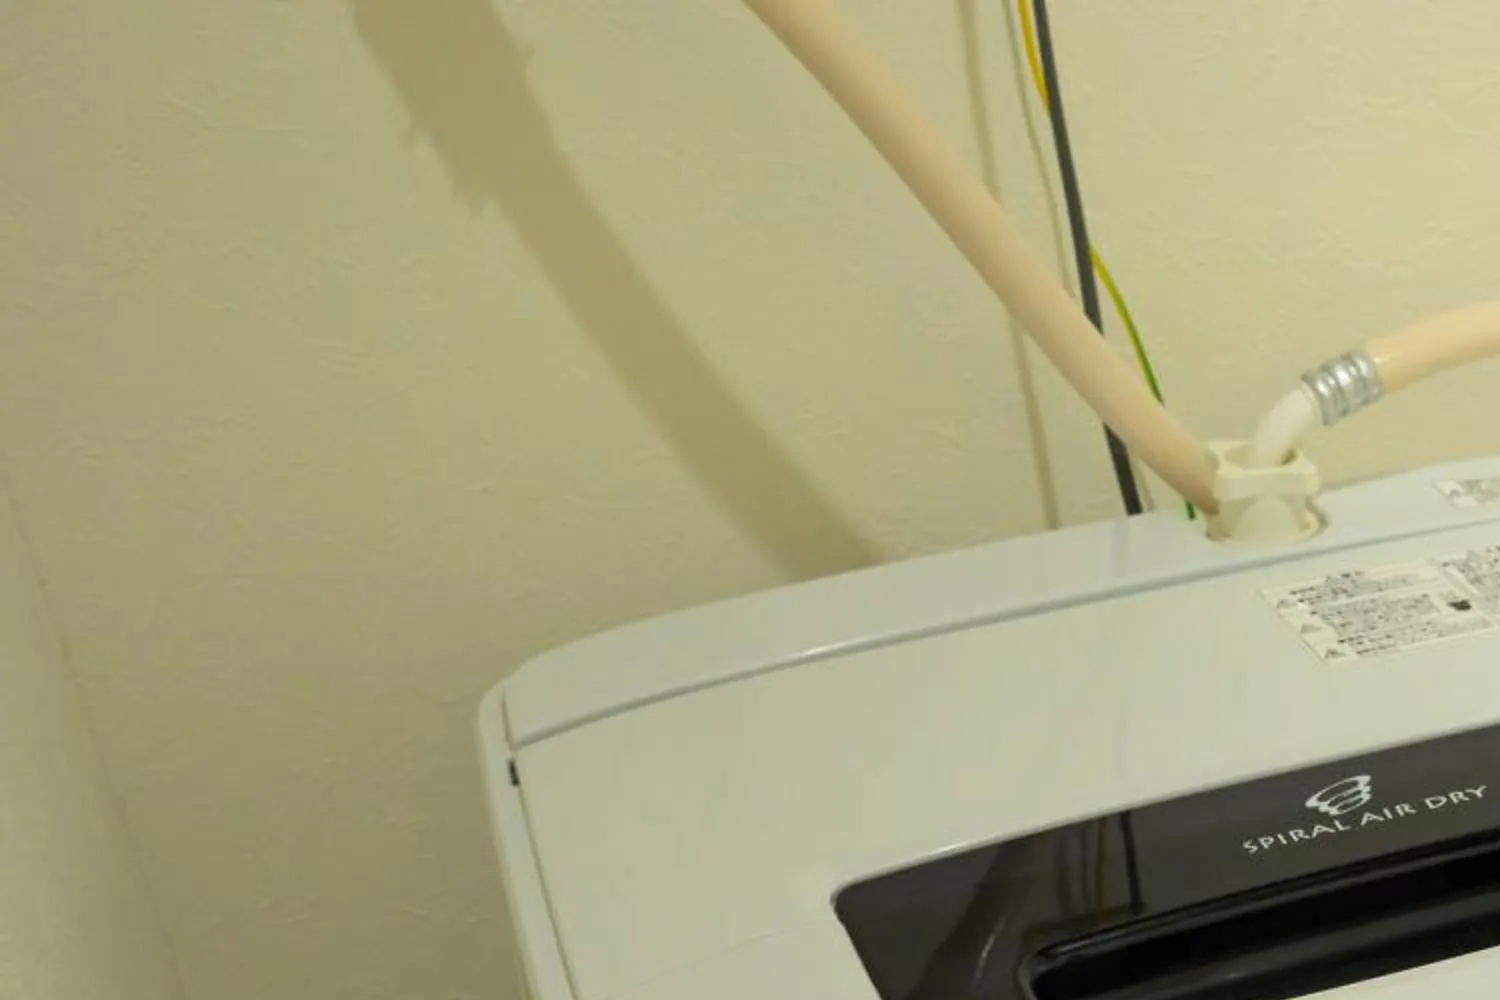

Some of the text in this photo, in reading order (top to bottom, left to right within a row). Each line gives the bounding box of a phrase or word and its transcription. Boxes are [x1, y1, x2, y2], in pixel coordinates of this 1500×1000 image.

[1243, 785, 1487, 854] SPIRAL AIR DRY
